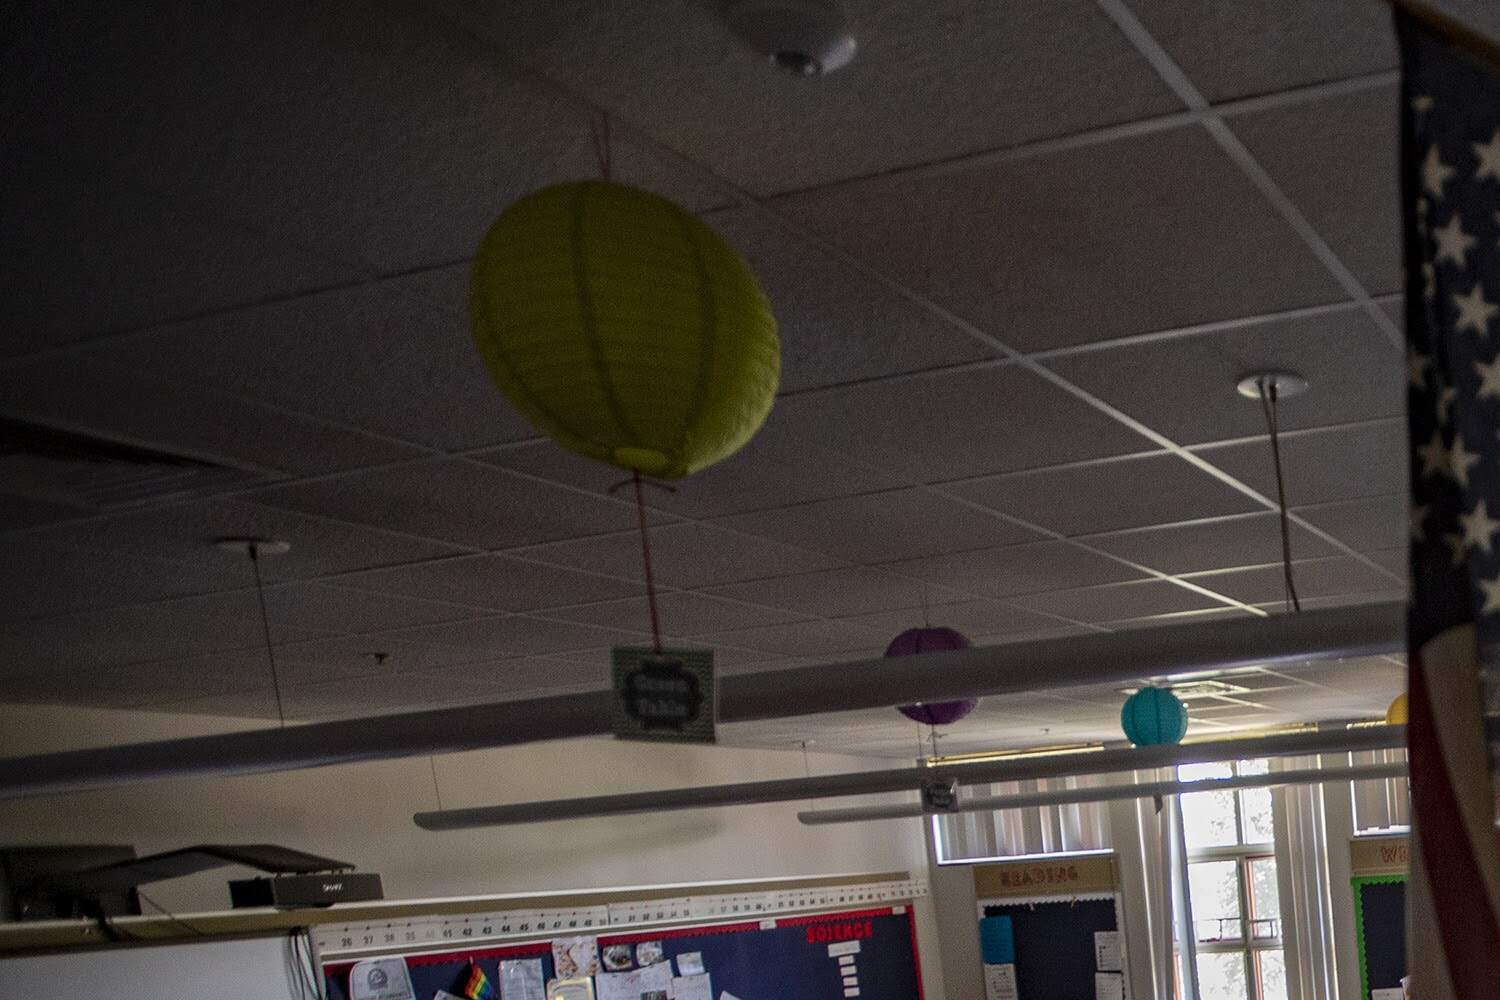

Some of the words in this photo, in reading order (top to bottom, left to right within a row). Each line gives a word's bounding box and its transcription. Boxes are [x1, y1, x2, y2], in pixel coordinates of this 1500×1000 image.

[1000, 866, 1078, 888] READING
[463, 928, 473, 936] 42
[482, 926, 492, 935] 43
[502, 924, 511, 933] 44
[806, 921, 873, 944] SCIENCE
